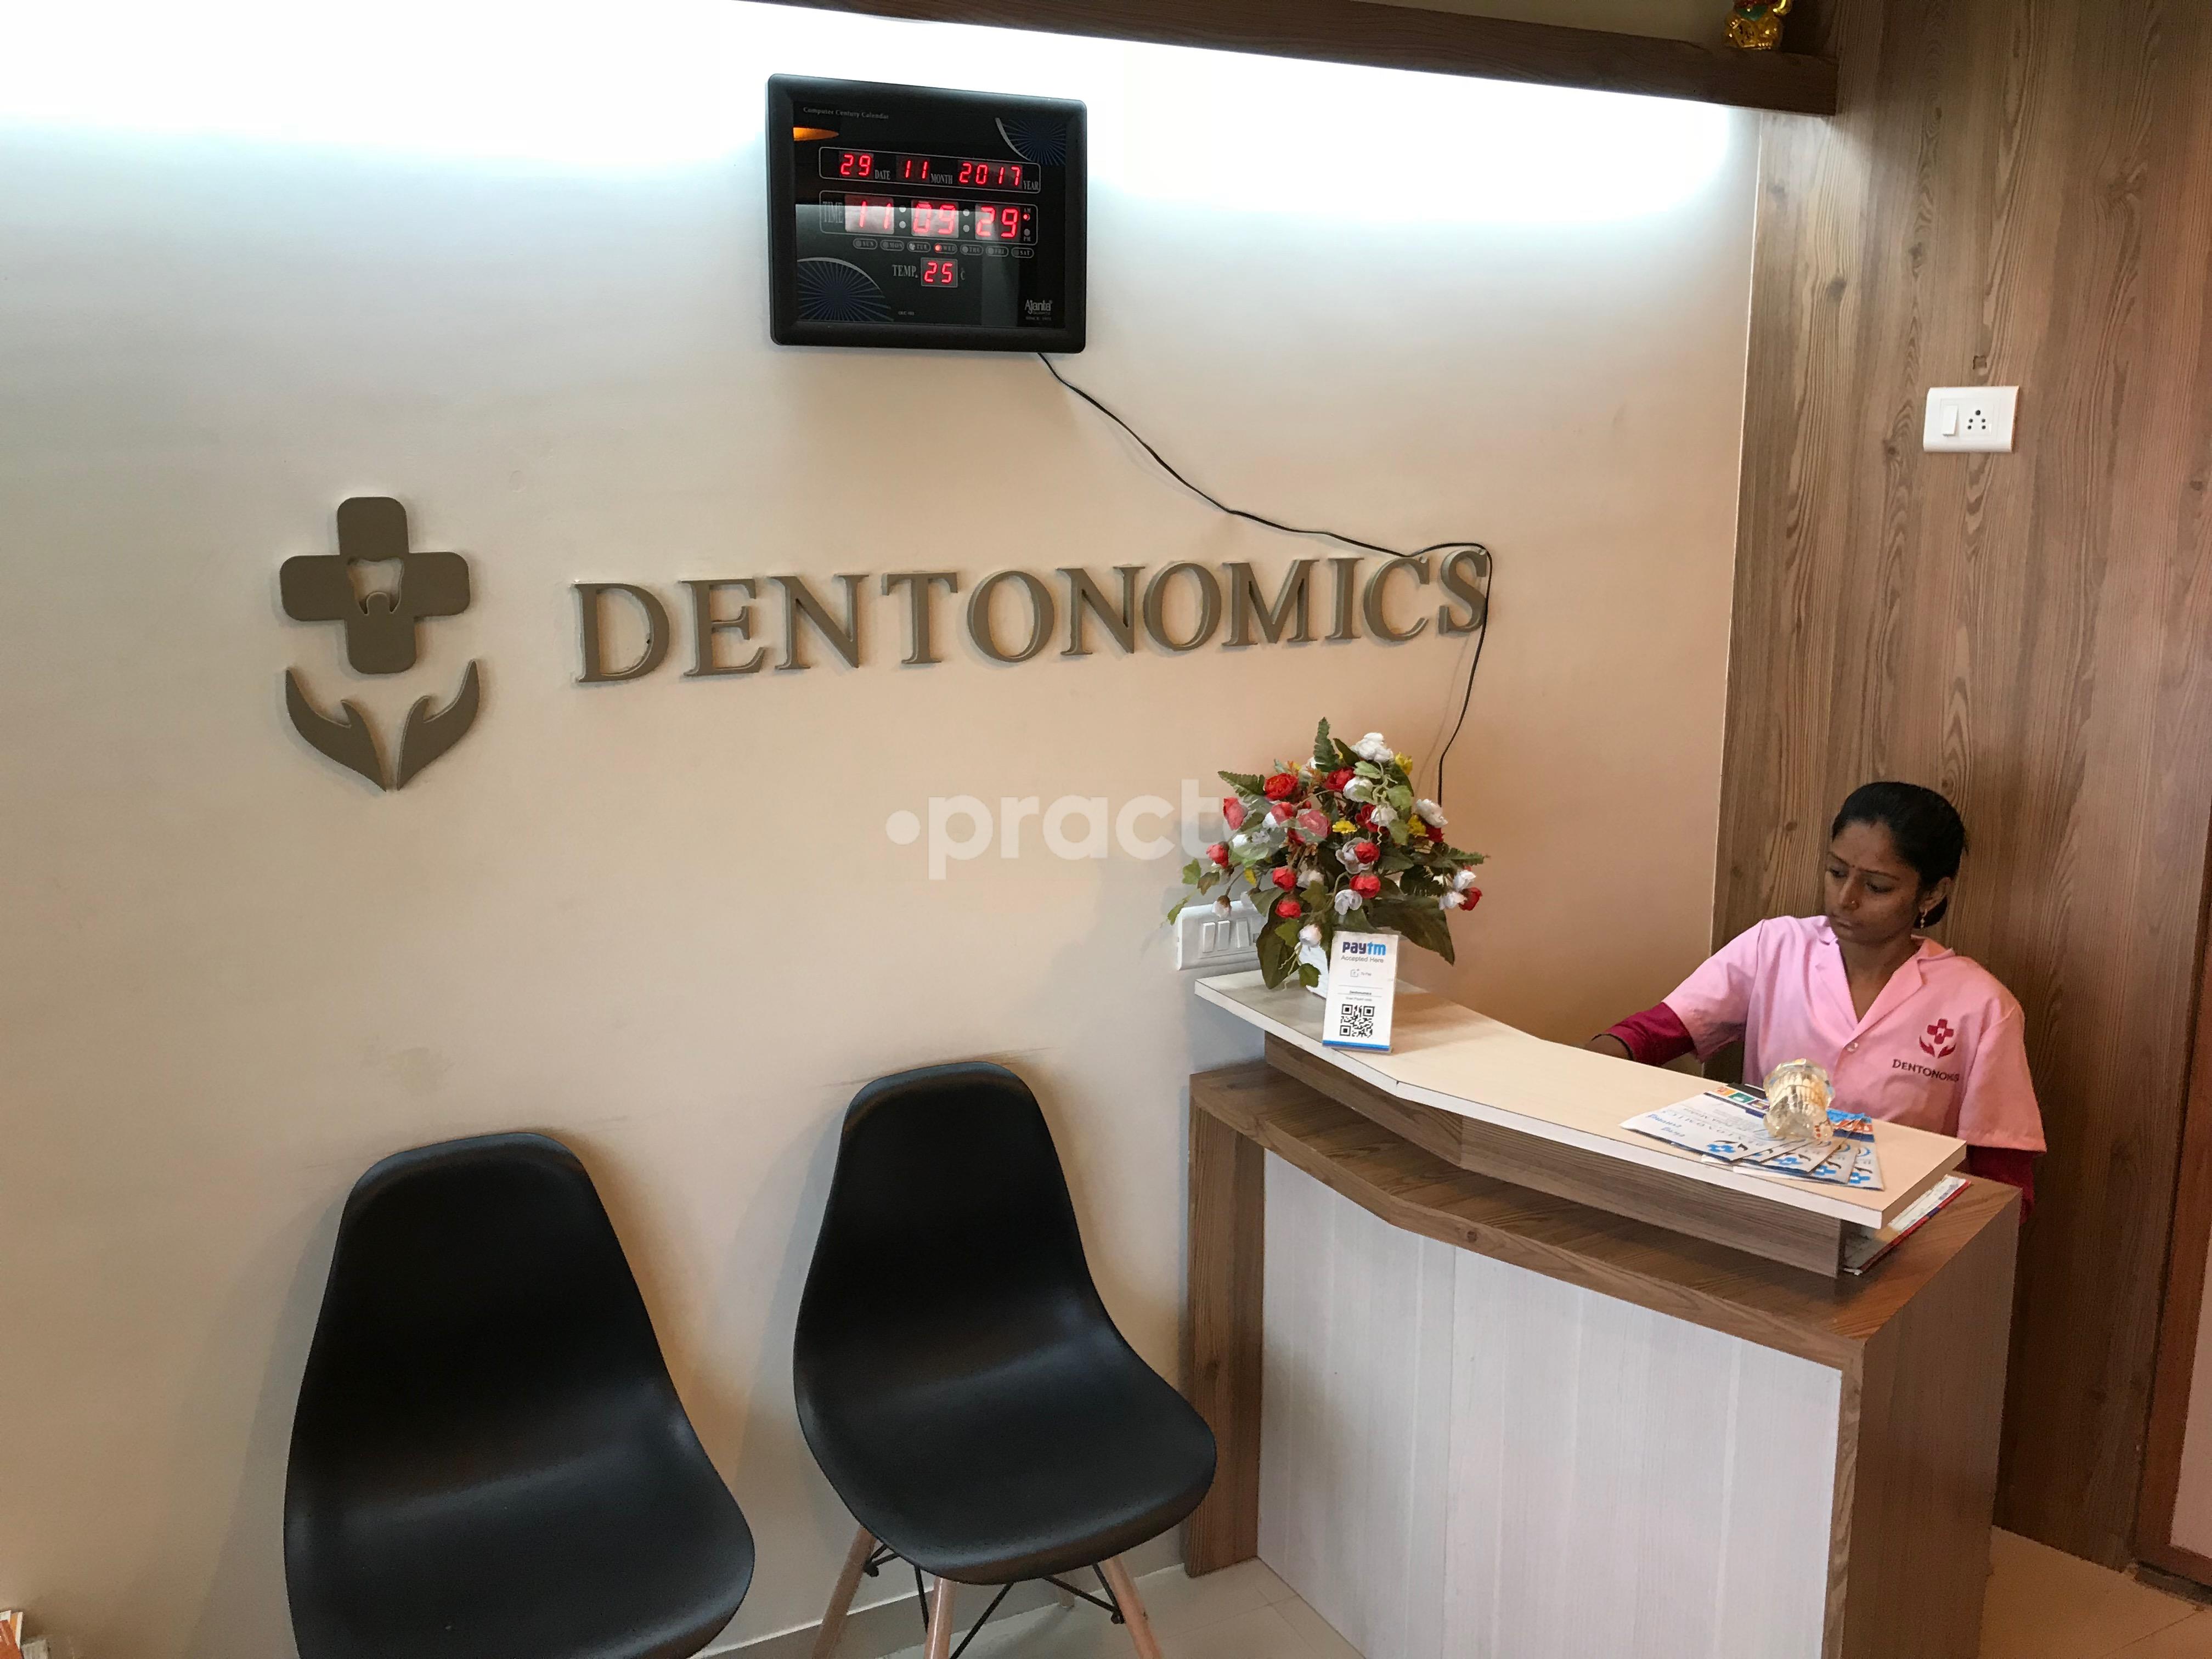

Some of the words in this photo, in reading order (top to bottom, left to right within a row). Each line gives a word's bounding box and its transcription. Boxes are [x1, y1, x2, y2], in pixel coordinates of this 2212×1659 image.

[840, 154, 872, 177] 29
[874, 169, 890, 180] DATE
[905, 160, 928, 179] 11
[930, 173, 953, 185] MONTH
[958, 162, 1022, 186] 2017
[1023, 180, 1039, 190] YEAR
[822, 201, 844, 224] TIME
[924, 261, 953, 284] 25
[1024, 299, 1052, 315] Ajanta
[571, 548, 1488, 685] DENTONOMICS
